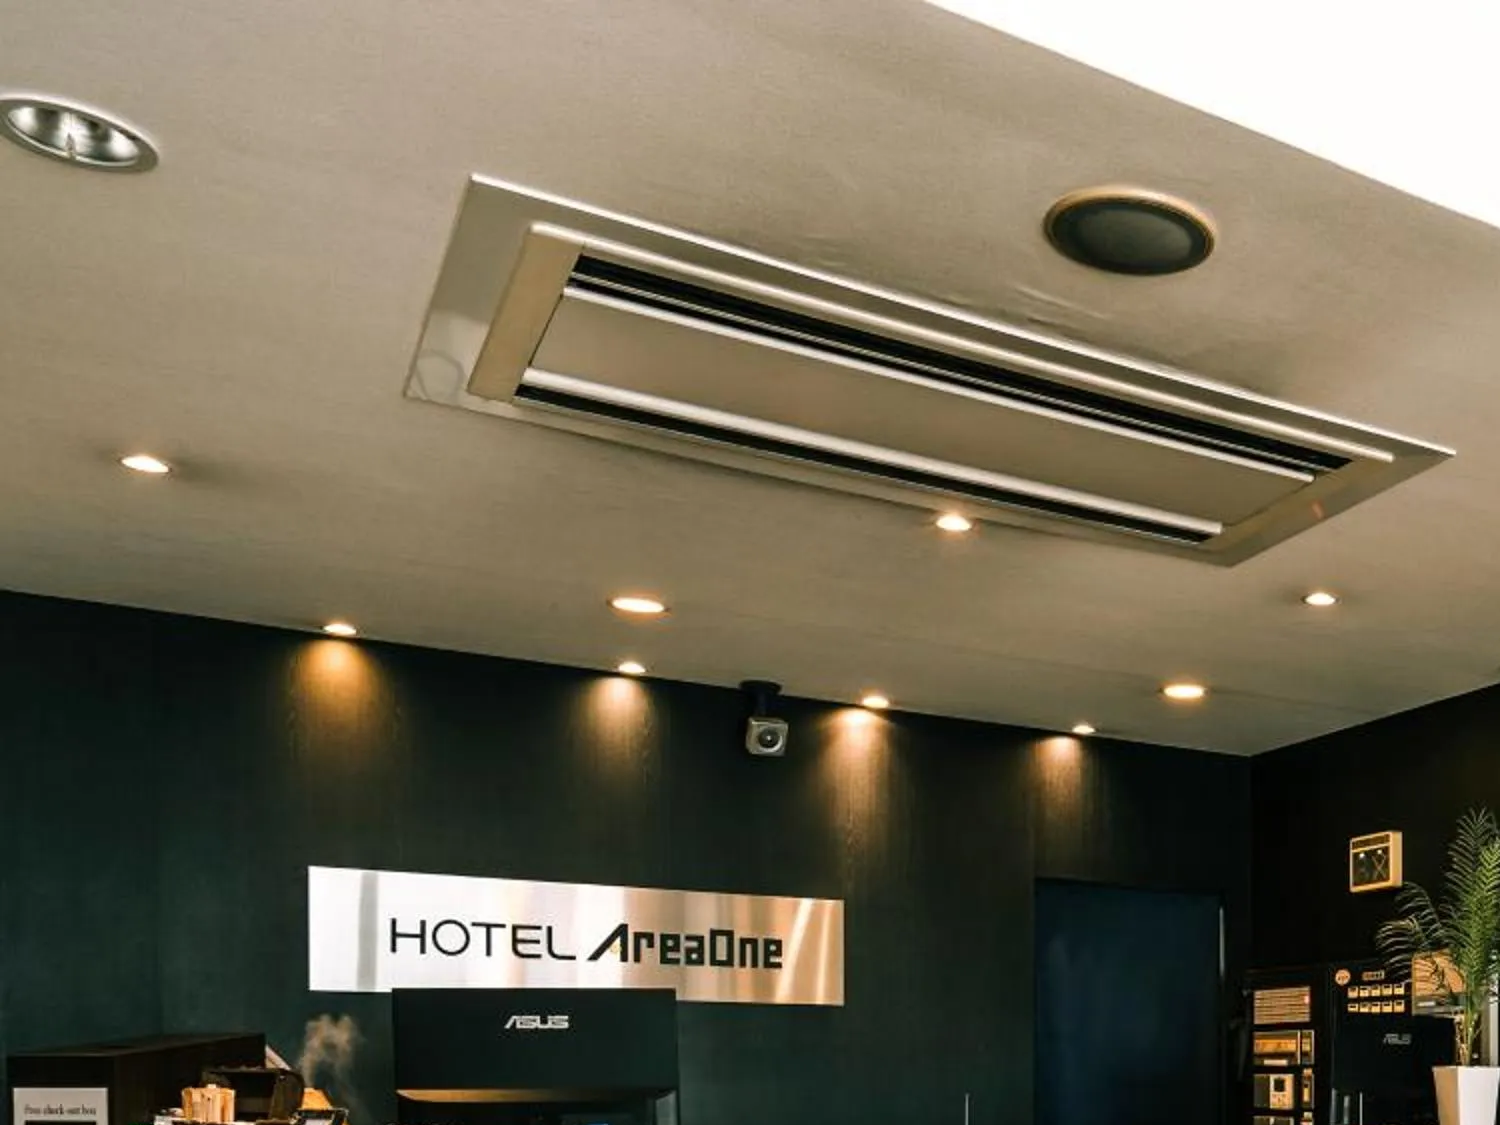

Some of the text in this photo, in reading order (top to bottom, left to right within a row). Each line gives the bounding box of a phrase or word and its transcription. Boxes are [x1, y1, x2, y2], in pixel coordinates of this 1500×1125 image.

[390, 917, 783, 969] HOTEL AreaOne
[504, 1015, 570, 1030] ASUS
